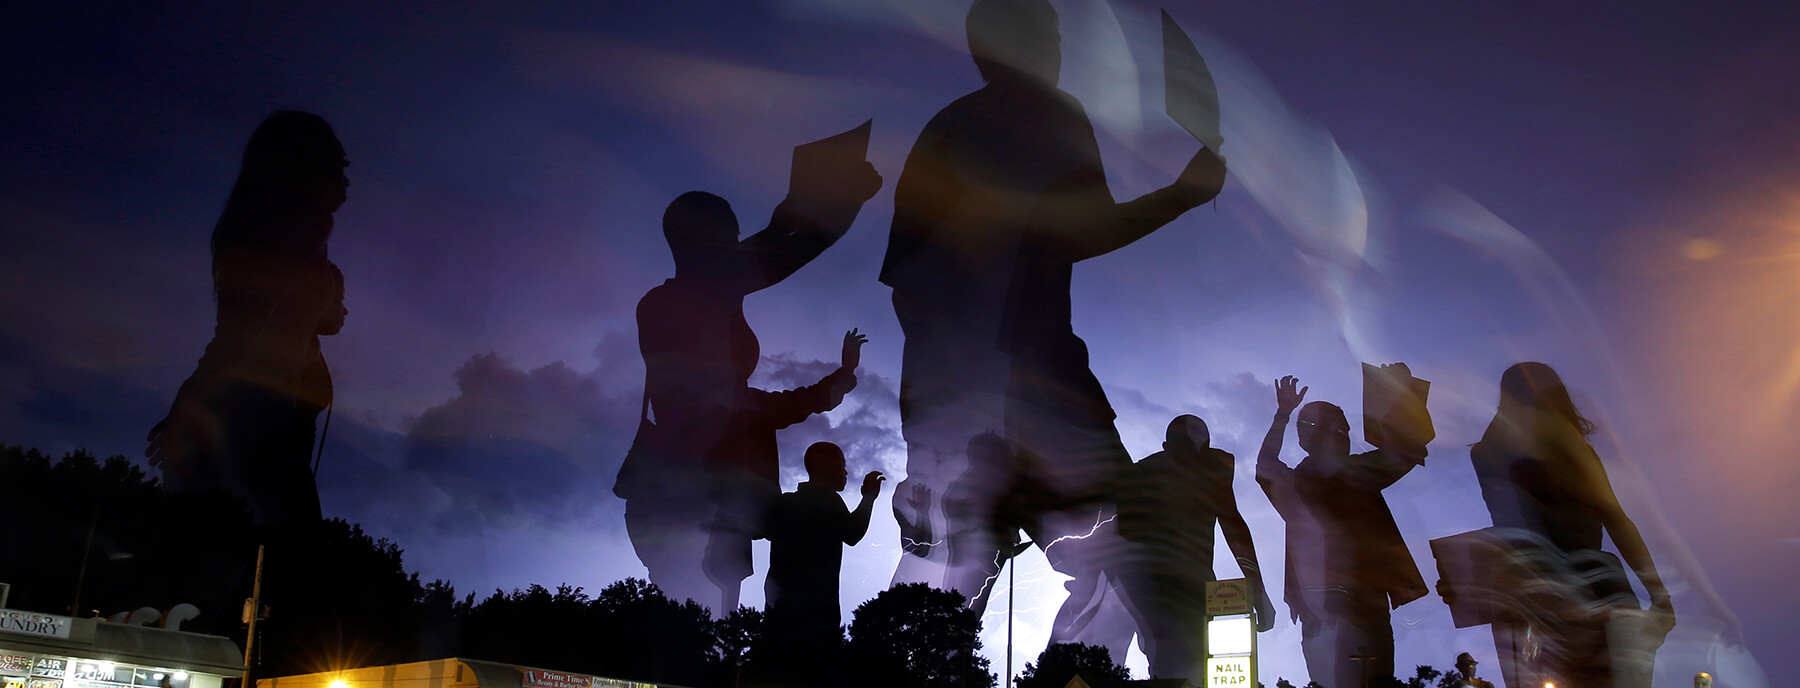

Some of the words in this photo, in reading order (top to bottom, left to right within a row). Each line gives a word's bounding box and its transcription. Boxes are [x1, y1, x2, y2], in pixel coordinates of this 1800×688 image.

[37, 658, 61, 669] AIR
[1216, 663, 1244, 673] NAIL
[543, 671, 565, 681] Prime
[566, 674, 584, 684] Time
[1213, 675, 1246, 685] TRAP
